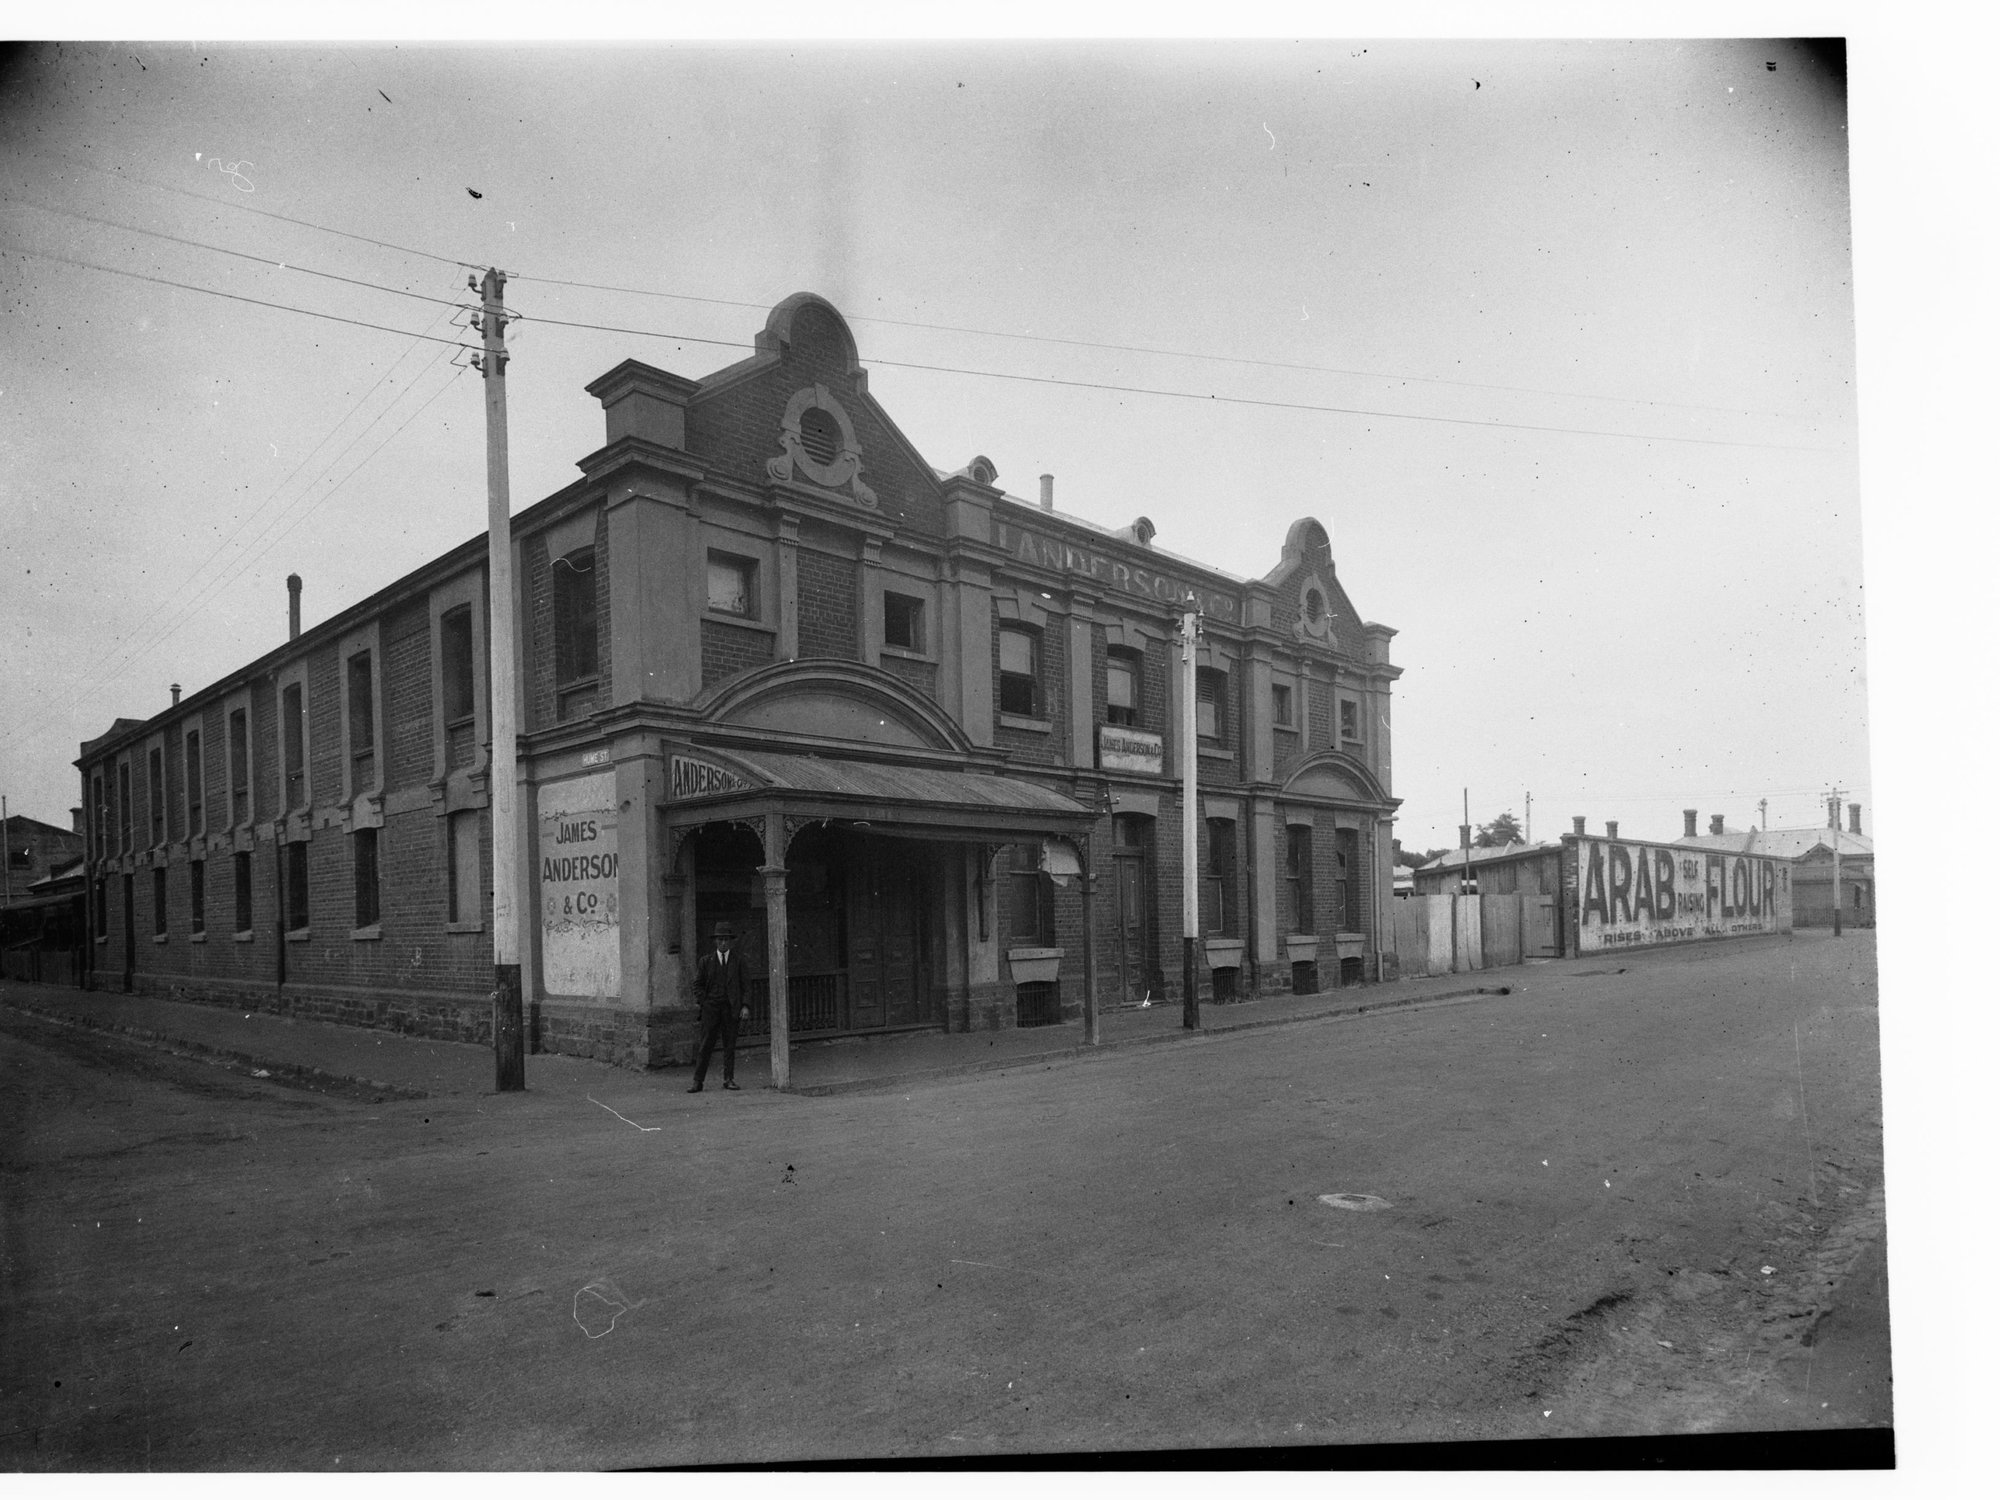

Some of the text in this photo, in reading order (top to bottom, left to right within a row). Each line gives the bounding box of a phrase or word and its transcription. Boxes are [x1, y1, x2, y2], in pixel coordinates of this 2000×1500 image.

[674, 759, 732, 796] ANDERSON
[556, 820, 597, 844] JAMES
[1683, 859, 1698, 879] SELF
[1582, 842, 1676, 925] ARAB
[1705, 854, 1775, 919] FLOUR
[563, 895, 572, 914] &
[1677, 892, 1704, 914] RAISING
[1604, 929, 1642, 945] RISES
[1654, 926, 1694, 939] ABOVE
[1731, 923, 1763, 933] OTHERS
